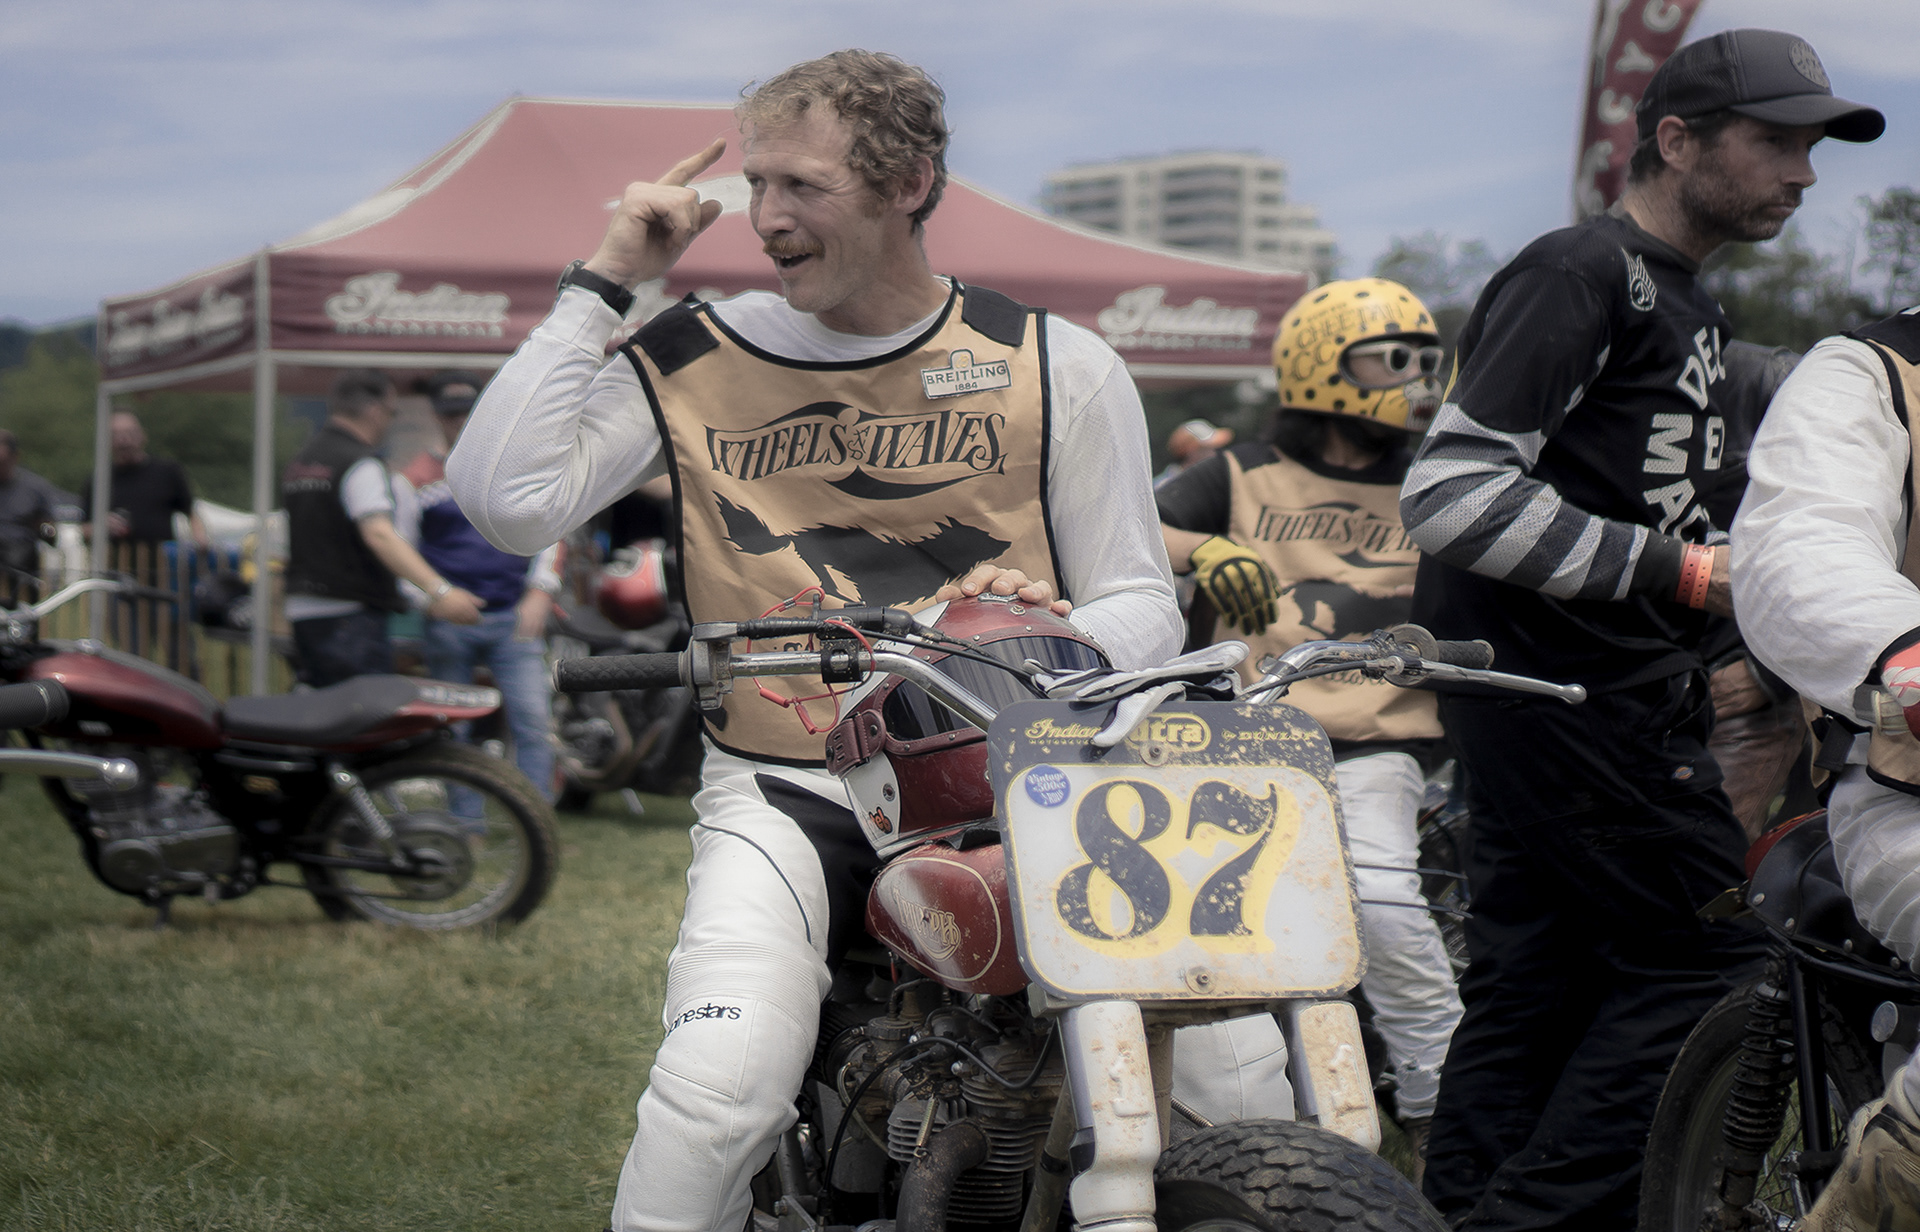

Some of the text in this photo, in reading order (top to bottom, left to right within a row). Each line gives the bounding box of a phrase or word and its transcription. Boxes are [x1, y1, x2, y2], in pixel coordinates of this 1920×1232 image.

[926, 365, 1007, 385] BREITLING
[955, 382, 978, 391] 1884
[703, 421, 848, 481] WHEELS
[865, 404, 1008, 475] WAVES
[1253, 505, 1353, 543] WHEELS
[1055, 777, 1285, 946] 87
